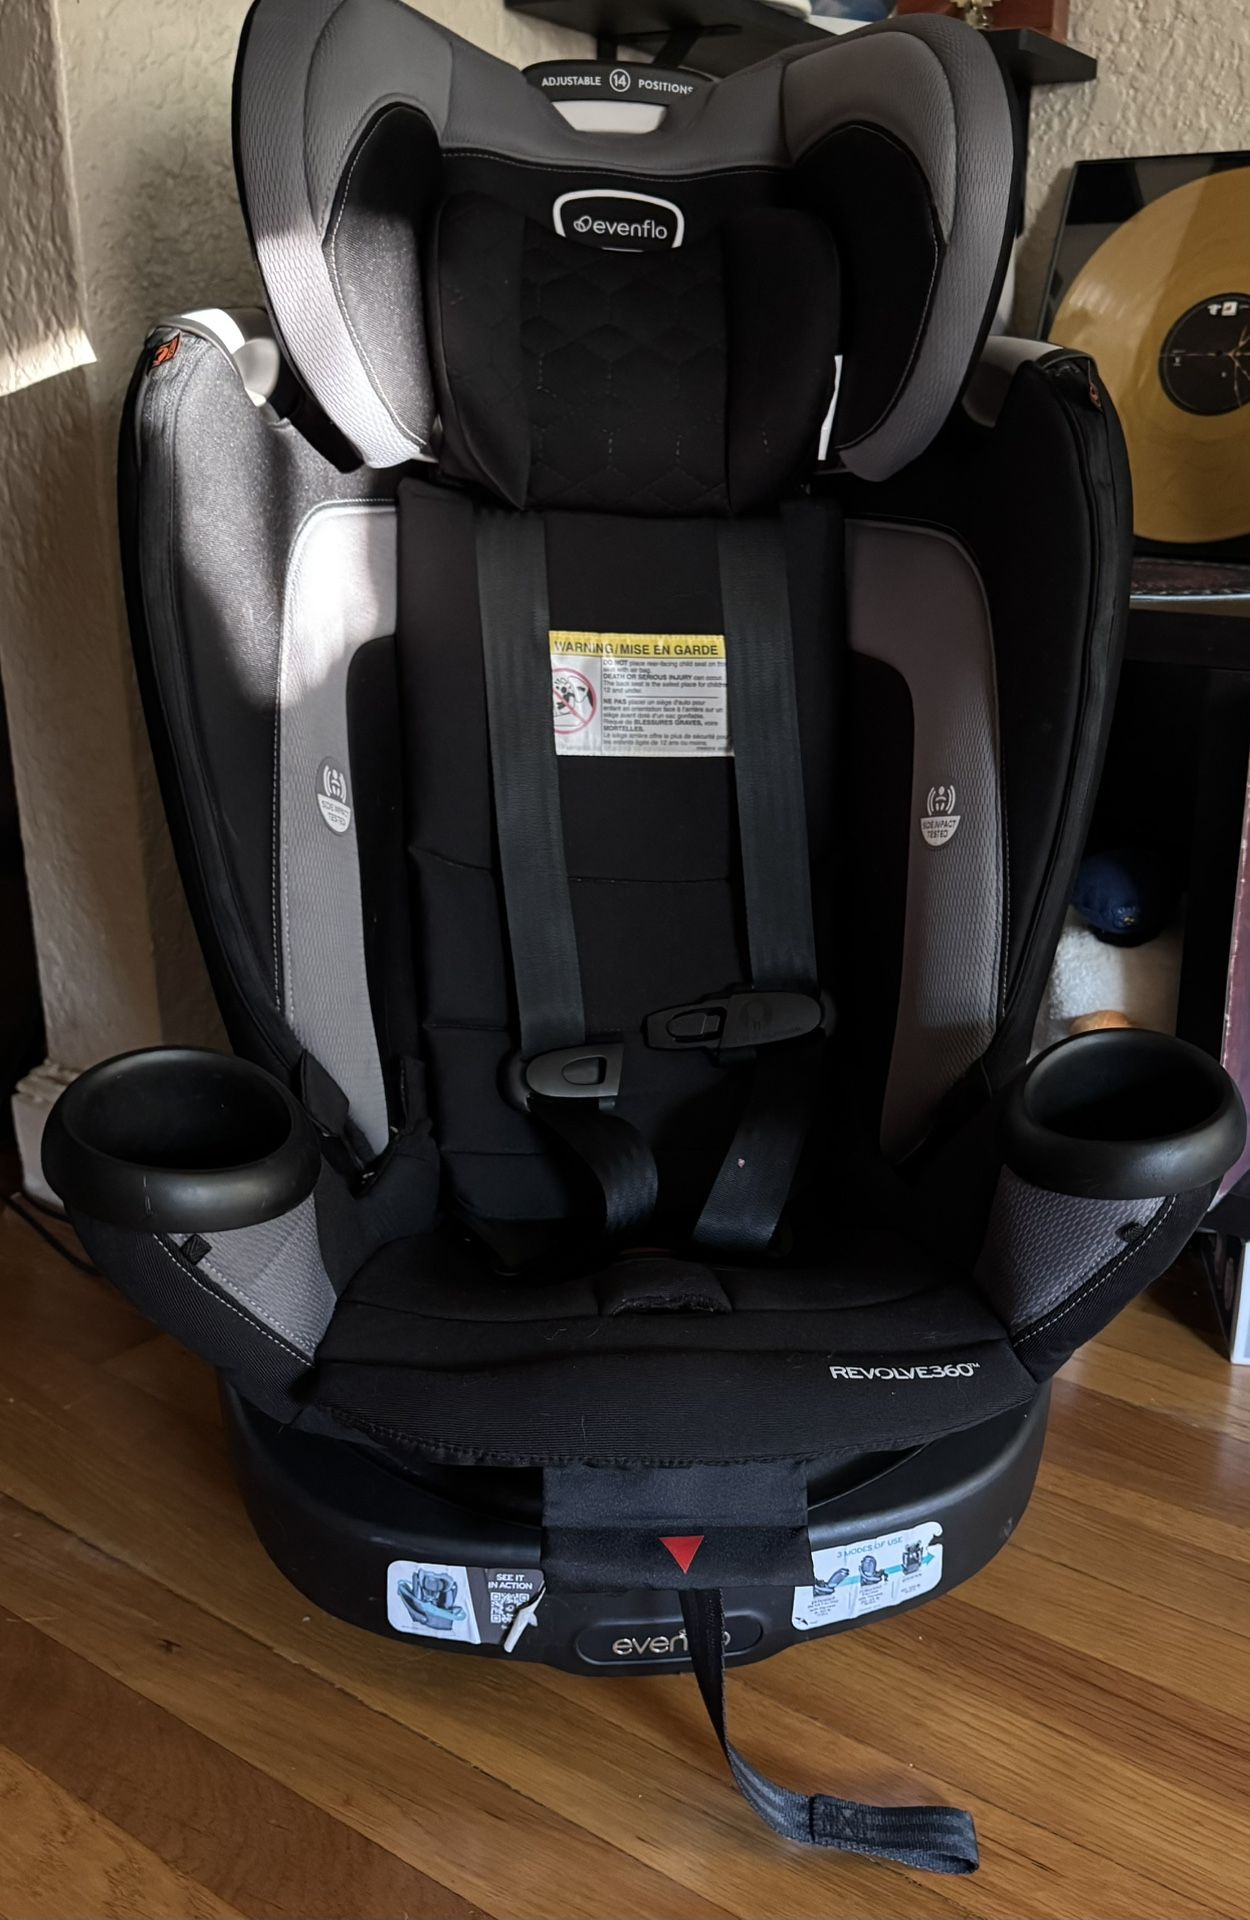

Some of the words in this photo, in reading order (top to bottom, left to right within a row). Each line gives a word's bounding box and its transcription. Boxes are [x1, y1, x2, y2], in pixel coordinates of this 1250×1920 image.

[541, 76, 601, 87] ADJUSTABLE
[613, 74, 627, 88] 14
[638, 79, 694, 95] POSITIONS
[593, 219, 668, 240] evenflo
[653, 645, 670, 656] EN
[674, 644, 719, 656] GARDE
[647, 661, 678, 669] rear-facing
[681, 681, 697, 689] place
[674, 719, 703, 727] GRAVES,
[328, 811, 347, 826] TESTED
[935, 820, 956, 829] IMPACT
[927, 830, 949, 838] TESTED
[844, 1545, 873, 1556] MODES
[874, 1541, 884, 1550] OF
[887, 1536, 904, 1547] USE
[496, 1573, 514, 1581] SEE
[515, 1574, 525, 1582] IT
[488, 1581, 500, 1589] IN
[500, 1582, 533, 1590] ACTION
